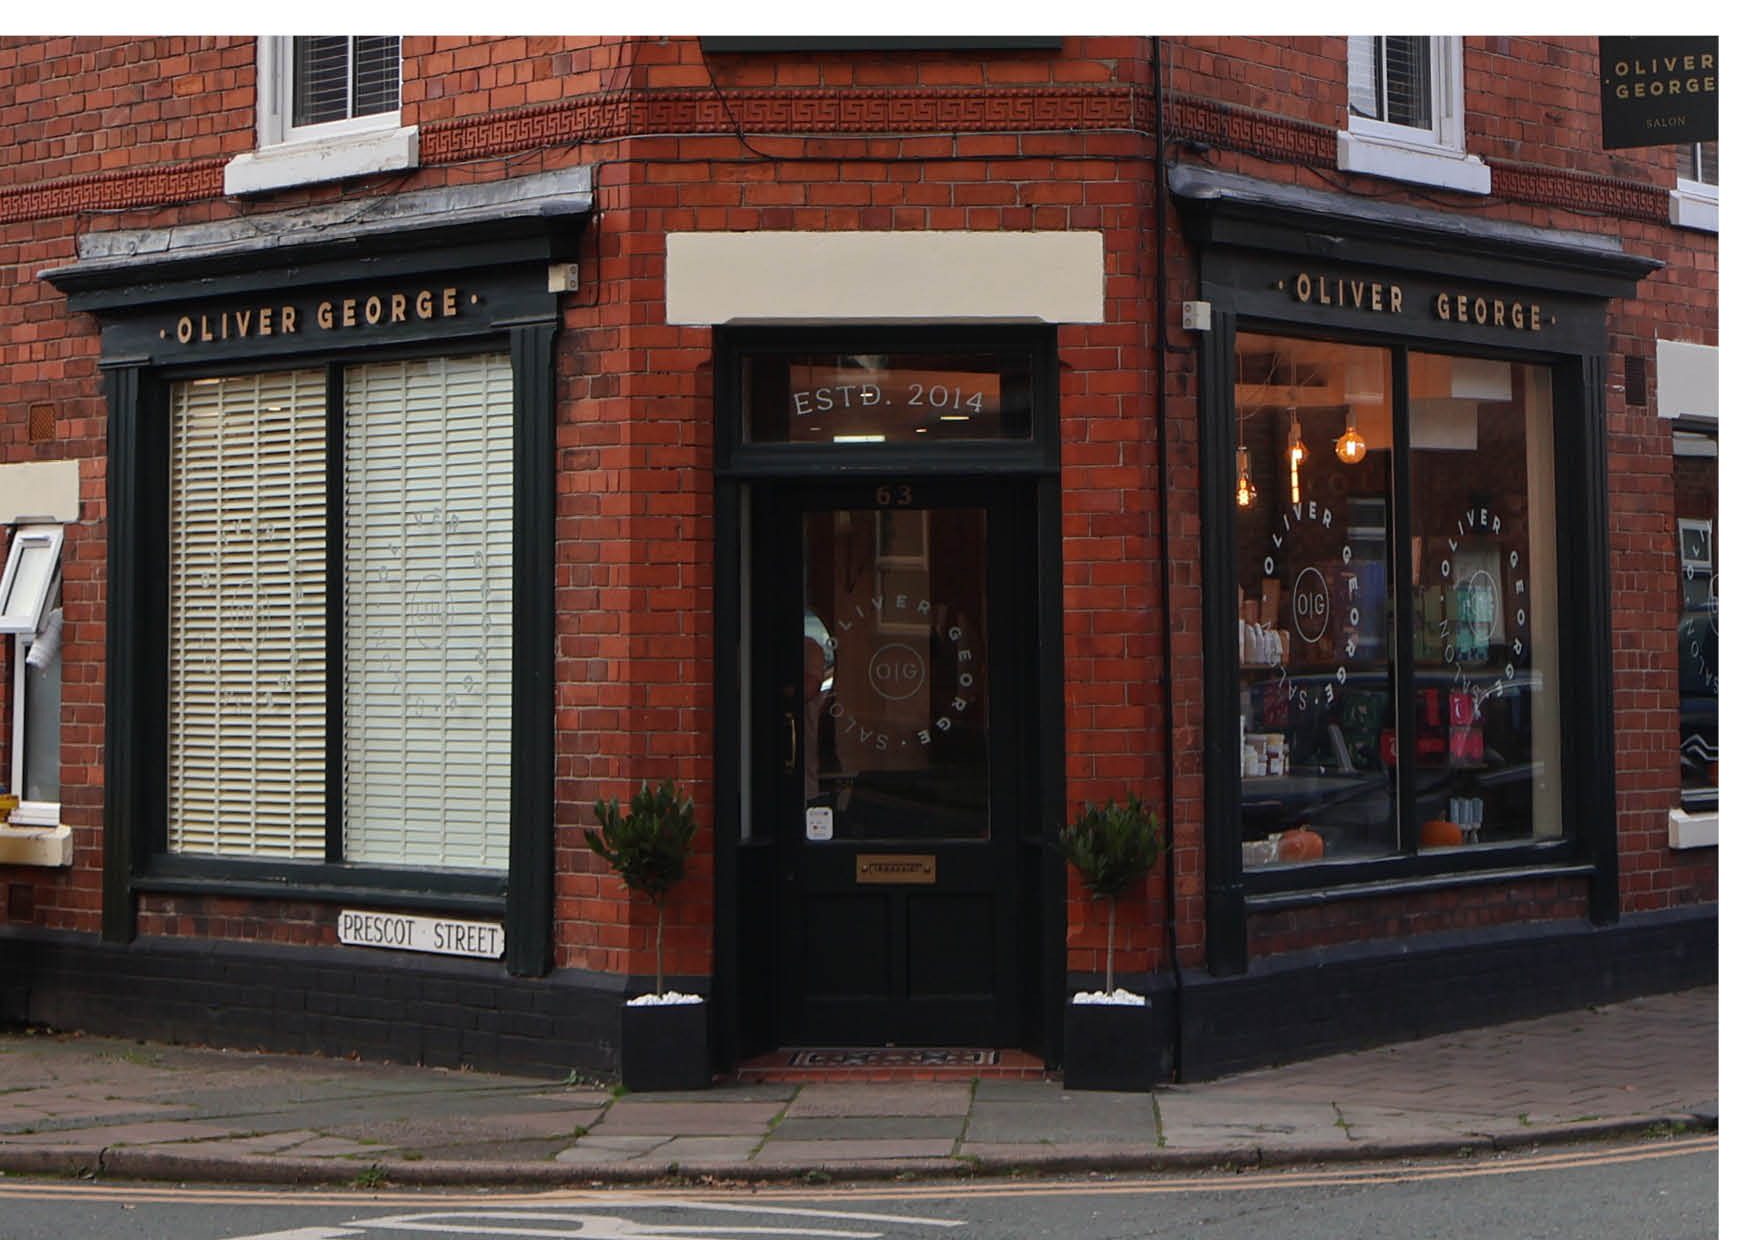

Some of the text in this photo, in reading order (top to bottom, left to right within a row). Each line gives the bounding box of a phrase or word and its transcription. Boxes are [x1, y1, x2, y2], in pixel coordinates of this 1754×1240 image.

[1615, 54, 1713, 77] OLIVER
[1616, 77, 1716, 99] GEORGE
[1647, 114, 1688, 129] SALON
[177, 288, 458, 344] OLIVER GEORGE
[1296, 272, 1542, 330] OLIVER GEORGE
[907, 382, 983, 413] 2014
[343, 913, 499, 954] PRESCOT STREET
